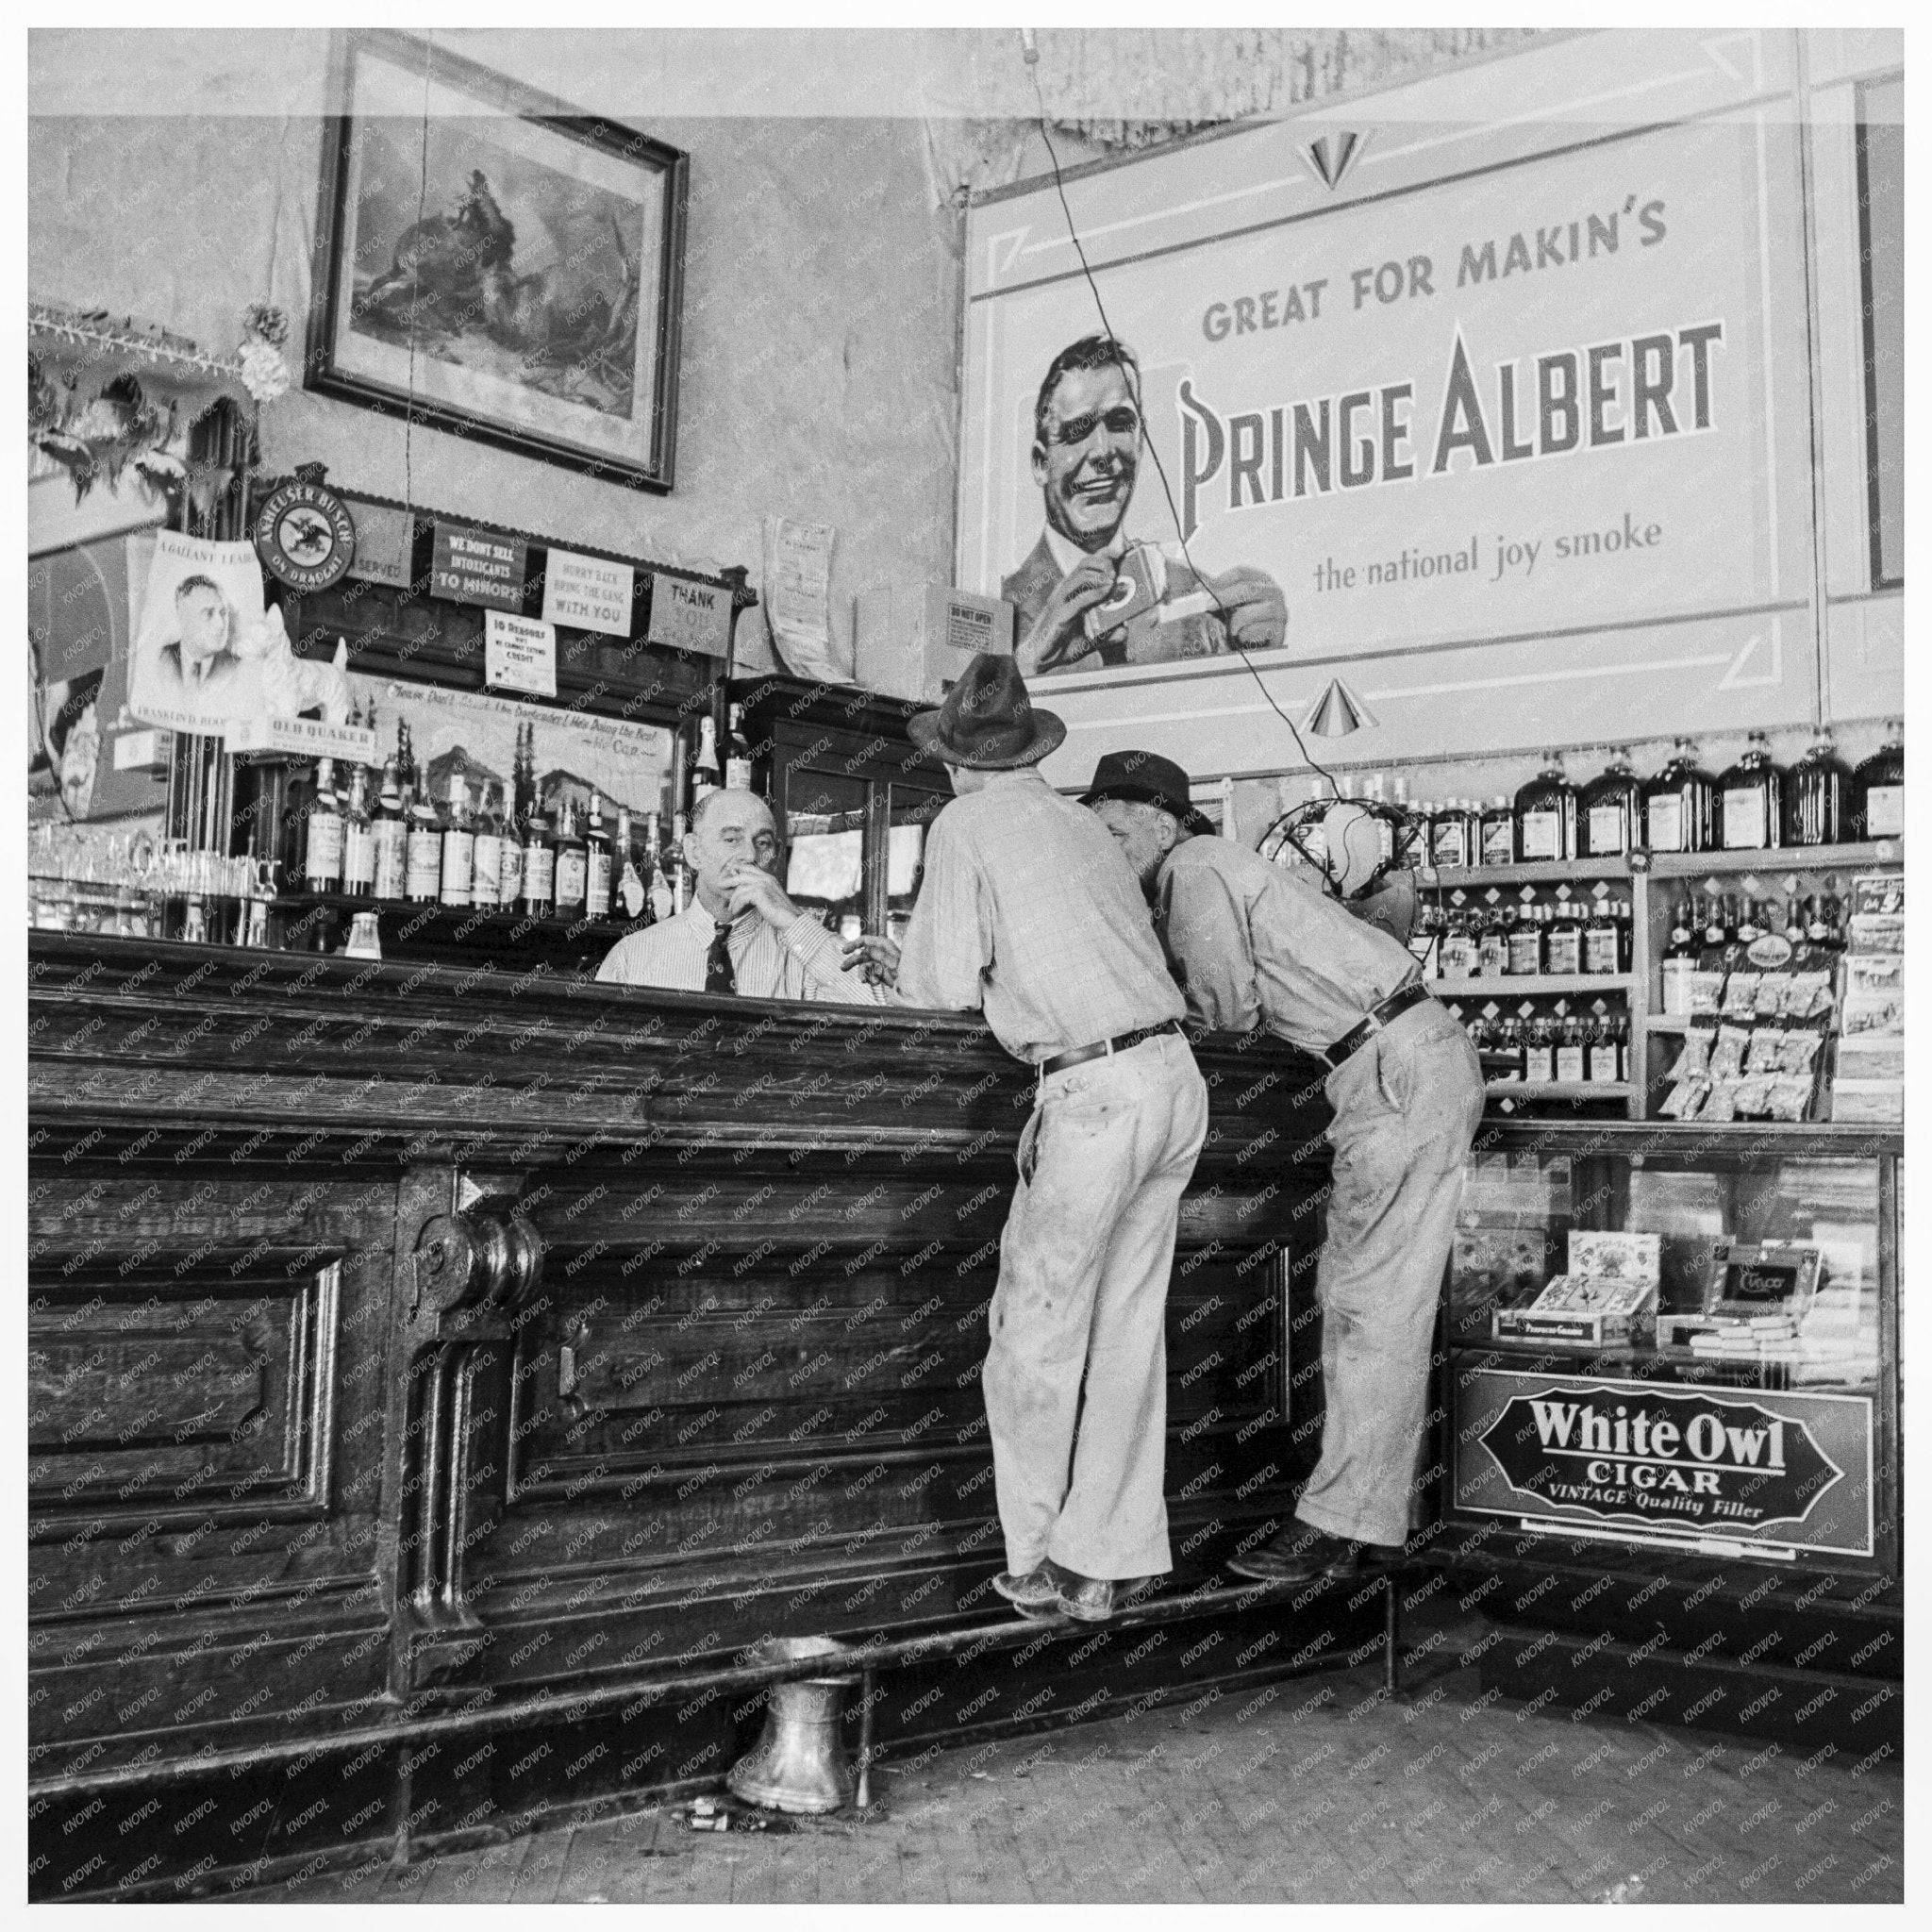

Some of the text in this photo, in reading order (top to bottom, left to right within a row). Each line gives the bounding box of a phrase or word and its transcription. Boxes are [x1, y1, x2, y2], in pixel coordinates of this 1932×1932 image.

[1202, 194, 1667, 342] GREAT FOR MAKIN'S
[1432, 321, 1724, 475] ALBERT
[318, 491, 353, 543] BUSCH
[449, 536, 466, 551] WE
[493, 545, 514, 561] SELL
[1312, 513, 1663, 591] the national joy smoke
[272, 555, 342, 585] ON DRAUGHT
[451, 555, 510, 578] INTOXICANTS
[563, 564, 592, 580] HURRY
[440, 573, 519, 600] TO MINORS
[585, 585, 600, 598] THE
[671, 584, 716, 610] THANK
[556, 598, 621, 623] WITH YOU
[951, 607, 991, 625] DO NOT OPEN
[507, 651, 533, 663] CREDIT
[273, 719, 369, 744] OLD QUAKER
[1529, 1401, 1786, 1468] White Owl
[1587, 1461, 1723, 1495] CIGAR
[1549, 1483, 1764, 1519] VINTAGE Quality Filler
